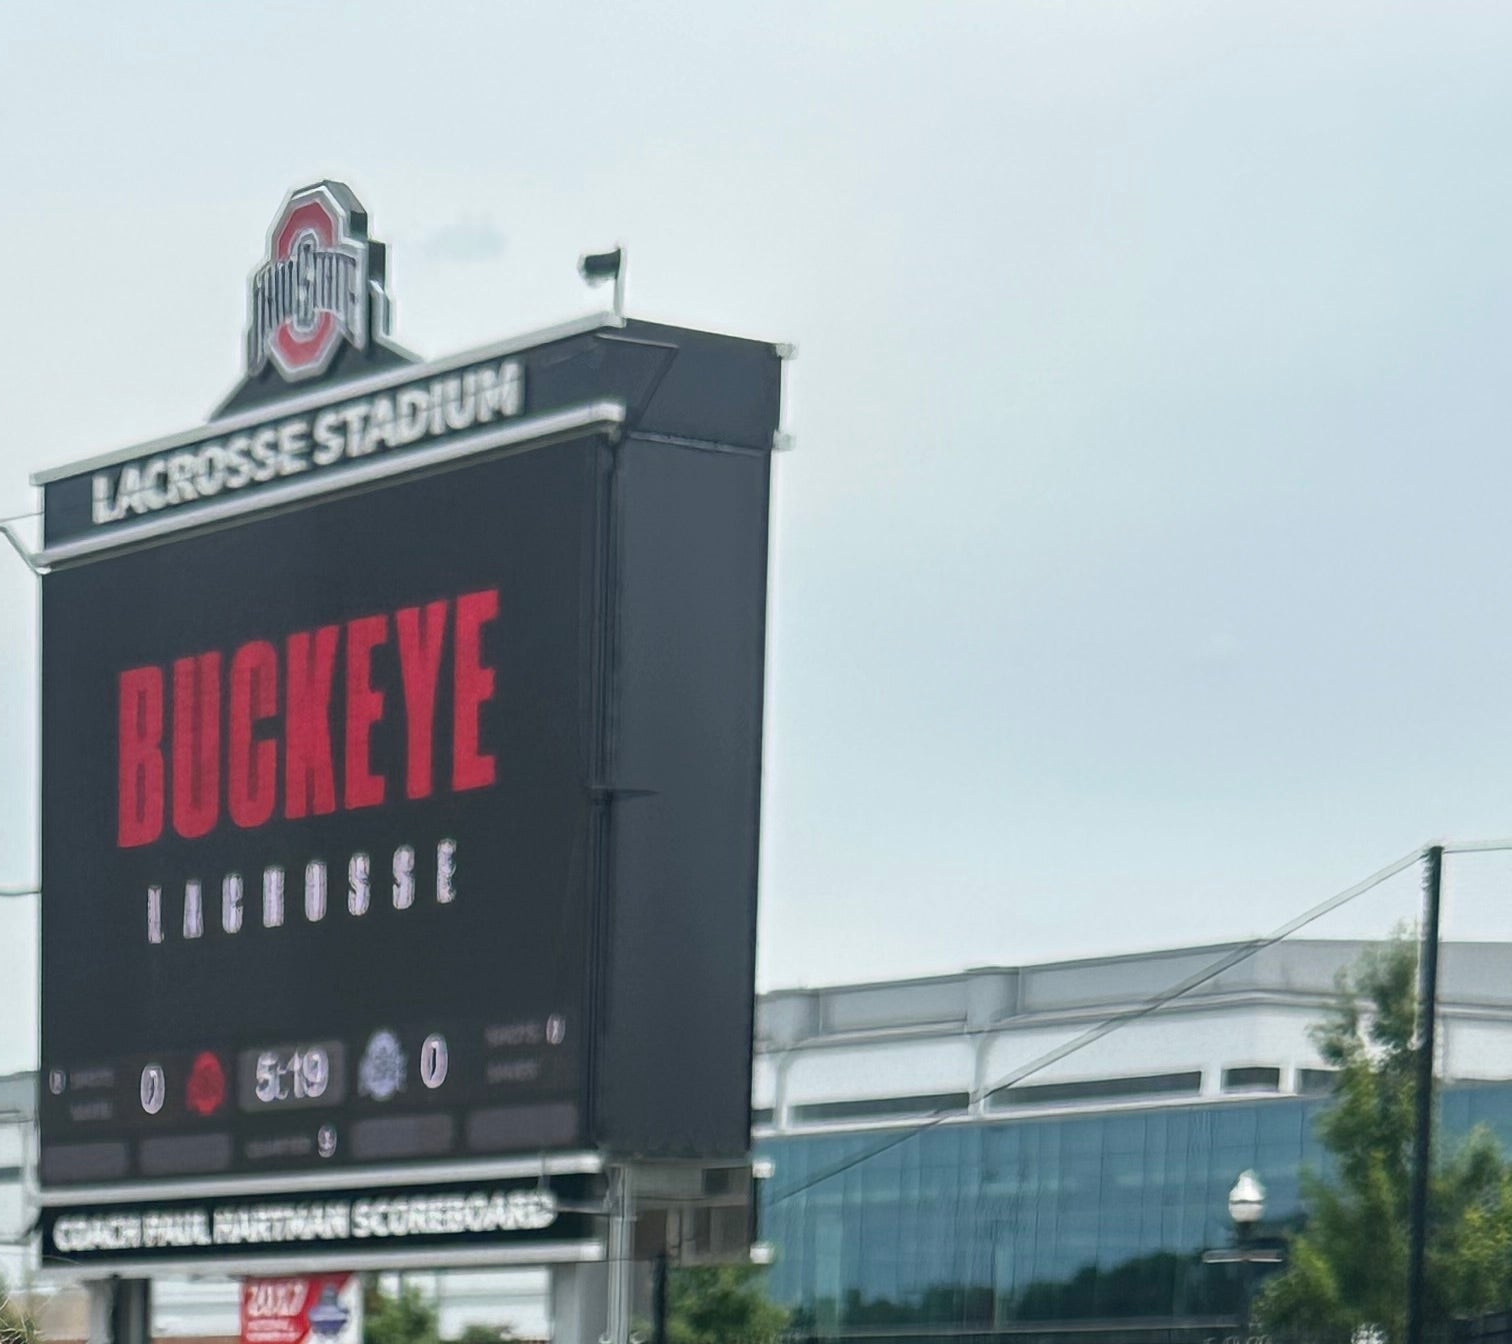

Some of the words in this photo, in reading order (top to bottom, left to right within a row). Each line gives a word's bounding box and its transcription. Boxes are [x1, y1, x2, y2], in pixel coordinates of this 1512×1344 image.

[91, 421, 309, 525] LACROSSE
[311, 358, 526, 467] STADIUM
[117, 588, 499, 848] BUCKEYE
[420, 1032, 448, 1089] 0
[140, 1064, 165, 1115] 0
[350, 1189, 557, 1237] SCOREBOARD
